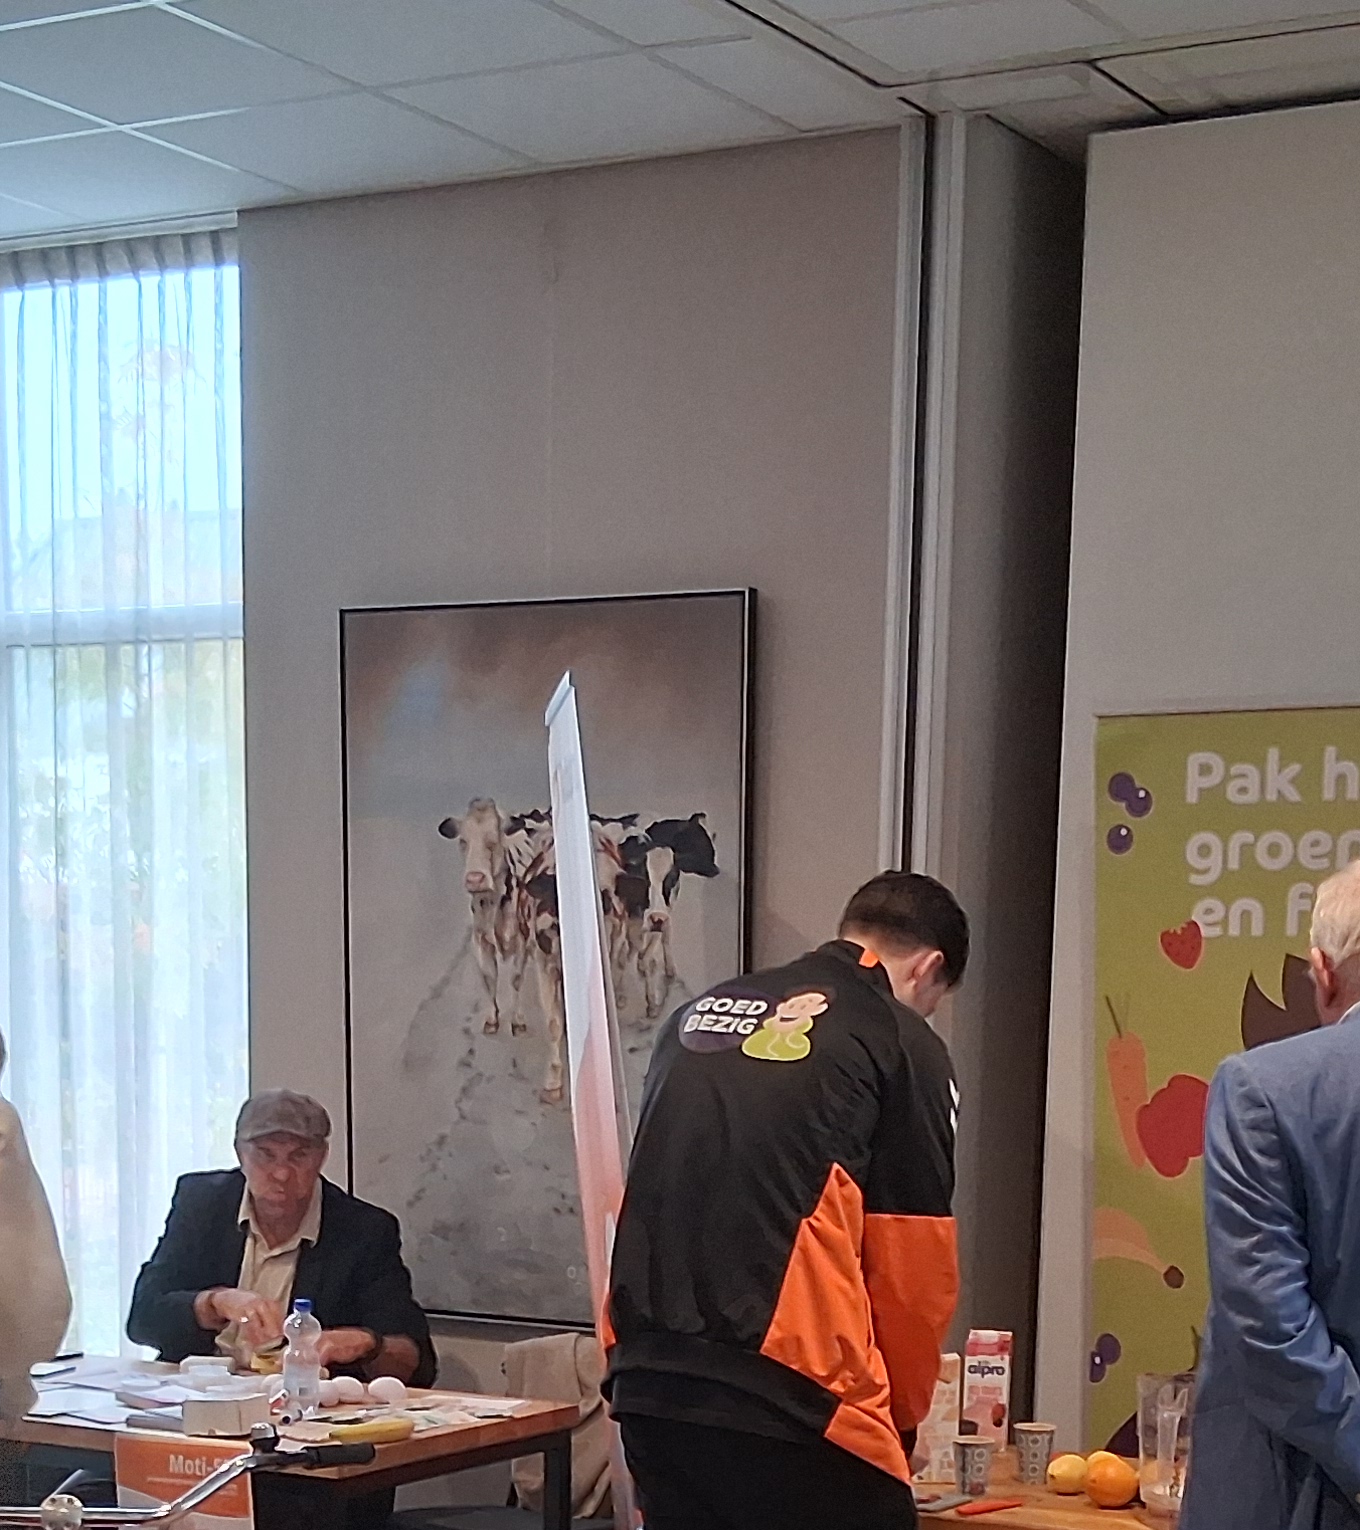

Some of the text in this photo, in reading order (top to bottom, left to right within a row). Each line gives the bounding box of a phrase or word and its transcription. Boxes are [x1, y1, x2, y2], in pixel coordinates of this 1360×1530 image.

[1184, 747, 1302, 805] Pak
[1192, 896, 1265, 938] en
[695, 995, 769, 1017] GOED
[683, 1013, 759, 1035] BEZIG
[968, 1360, 1005, 1379] alpro
